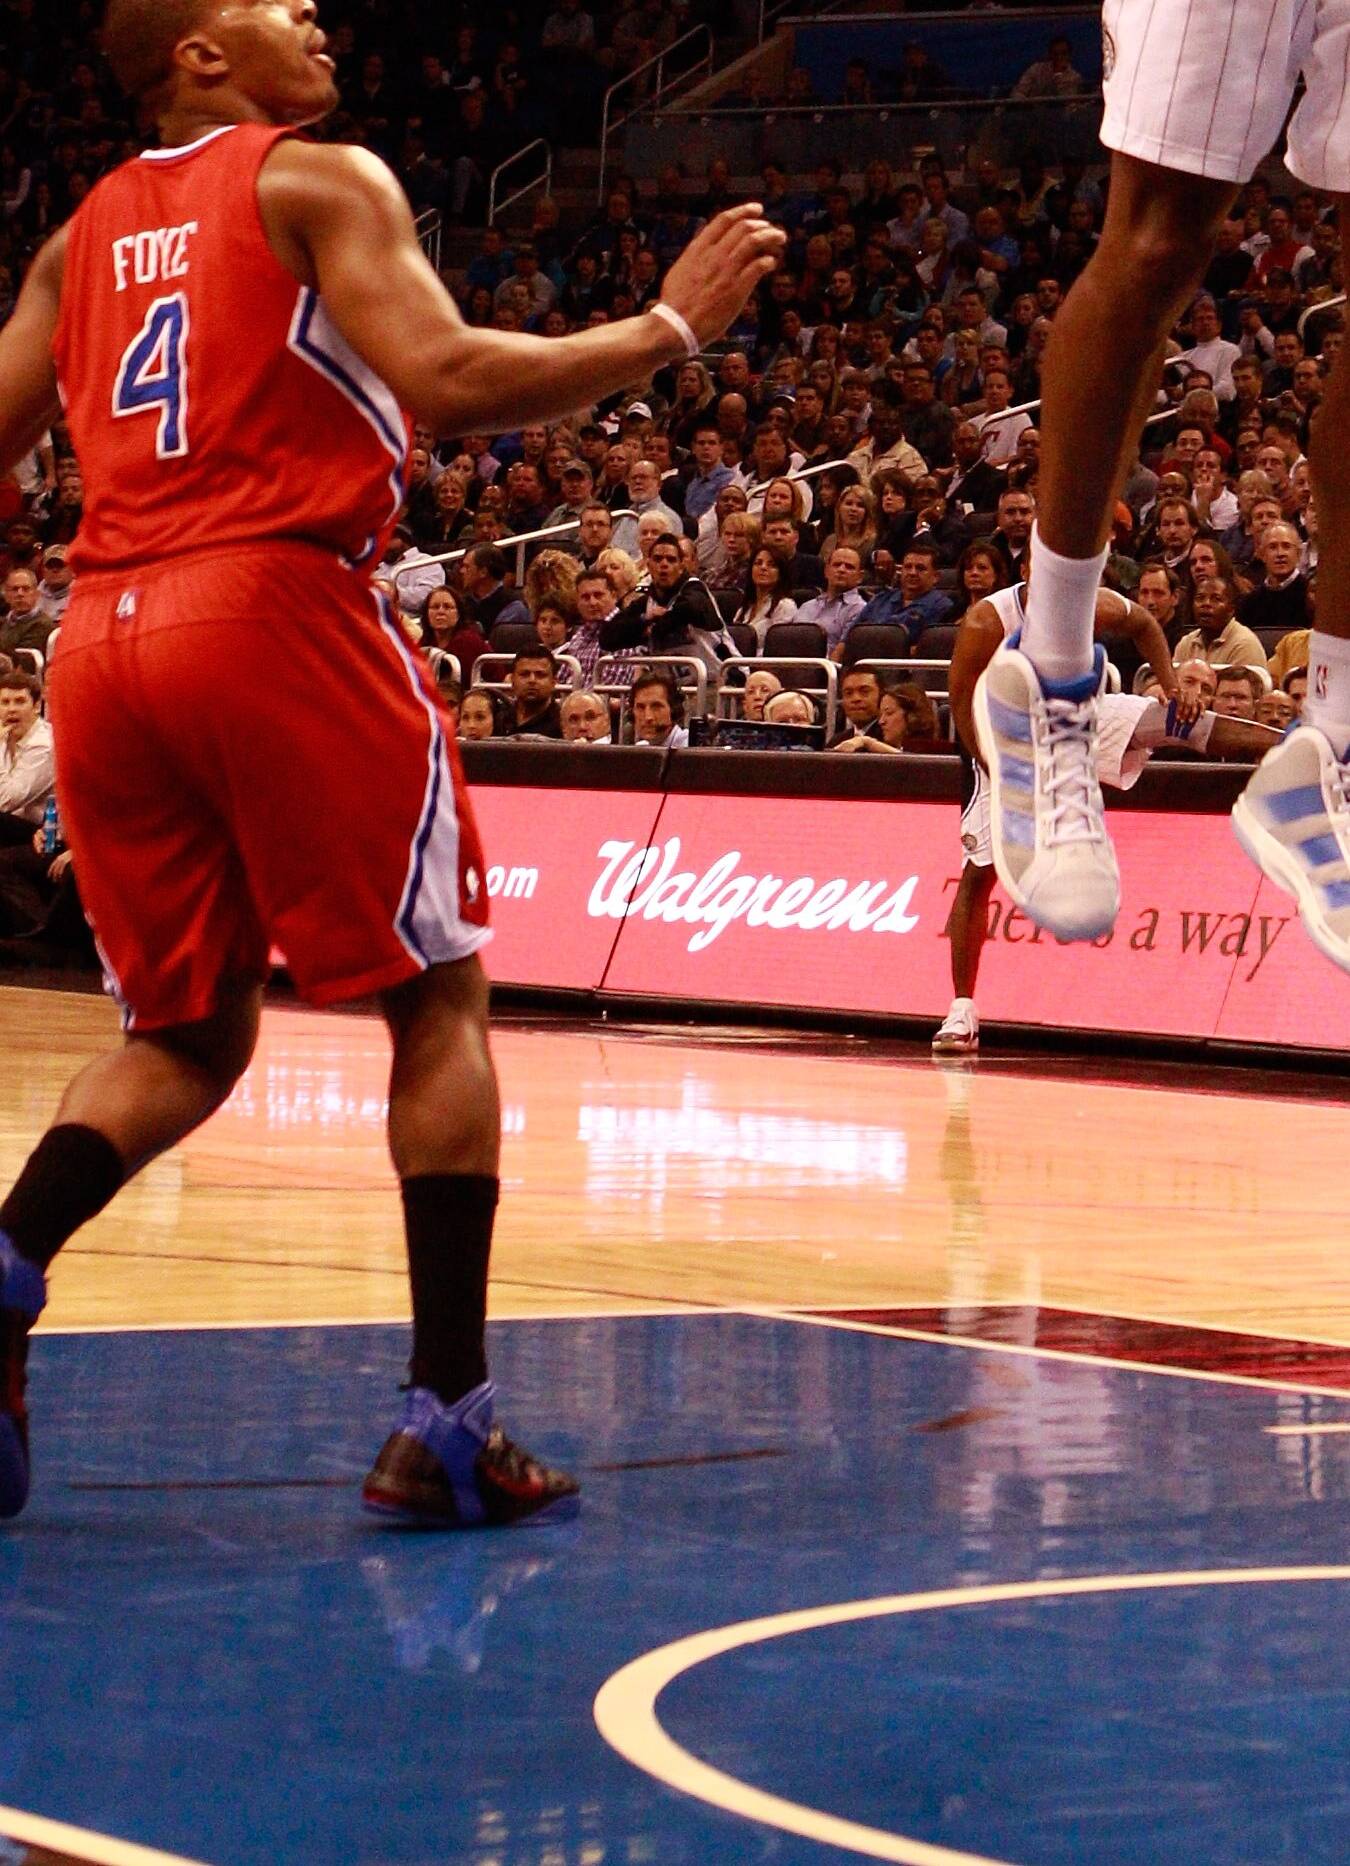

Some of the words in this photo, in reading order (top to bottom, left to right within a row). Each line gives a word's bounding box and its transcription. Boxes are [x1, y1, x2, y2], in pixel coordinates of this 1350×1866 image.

[111, 220, 199, 294] FOYE
[111, 291, 191, 461] 4
[587, 836, 920, 953] Walgreens
[1129, 907, 1160, 953] a
[1179, 910, 1291, 983] way
